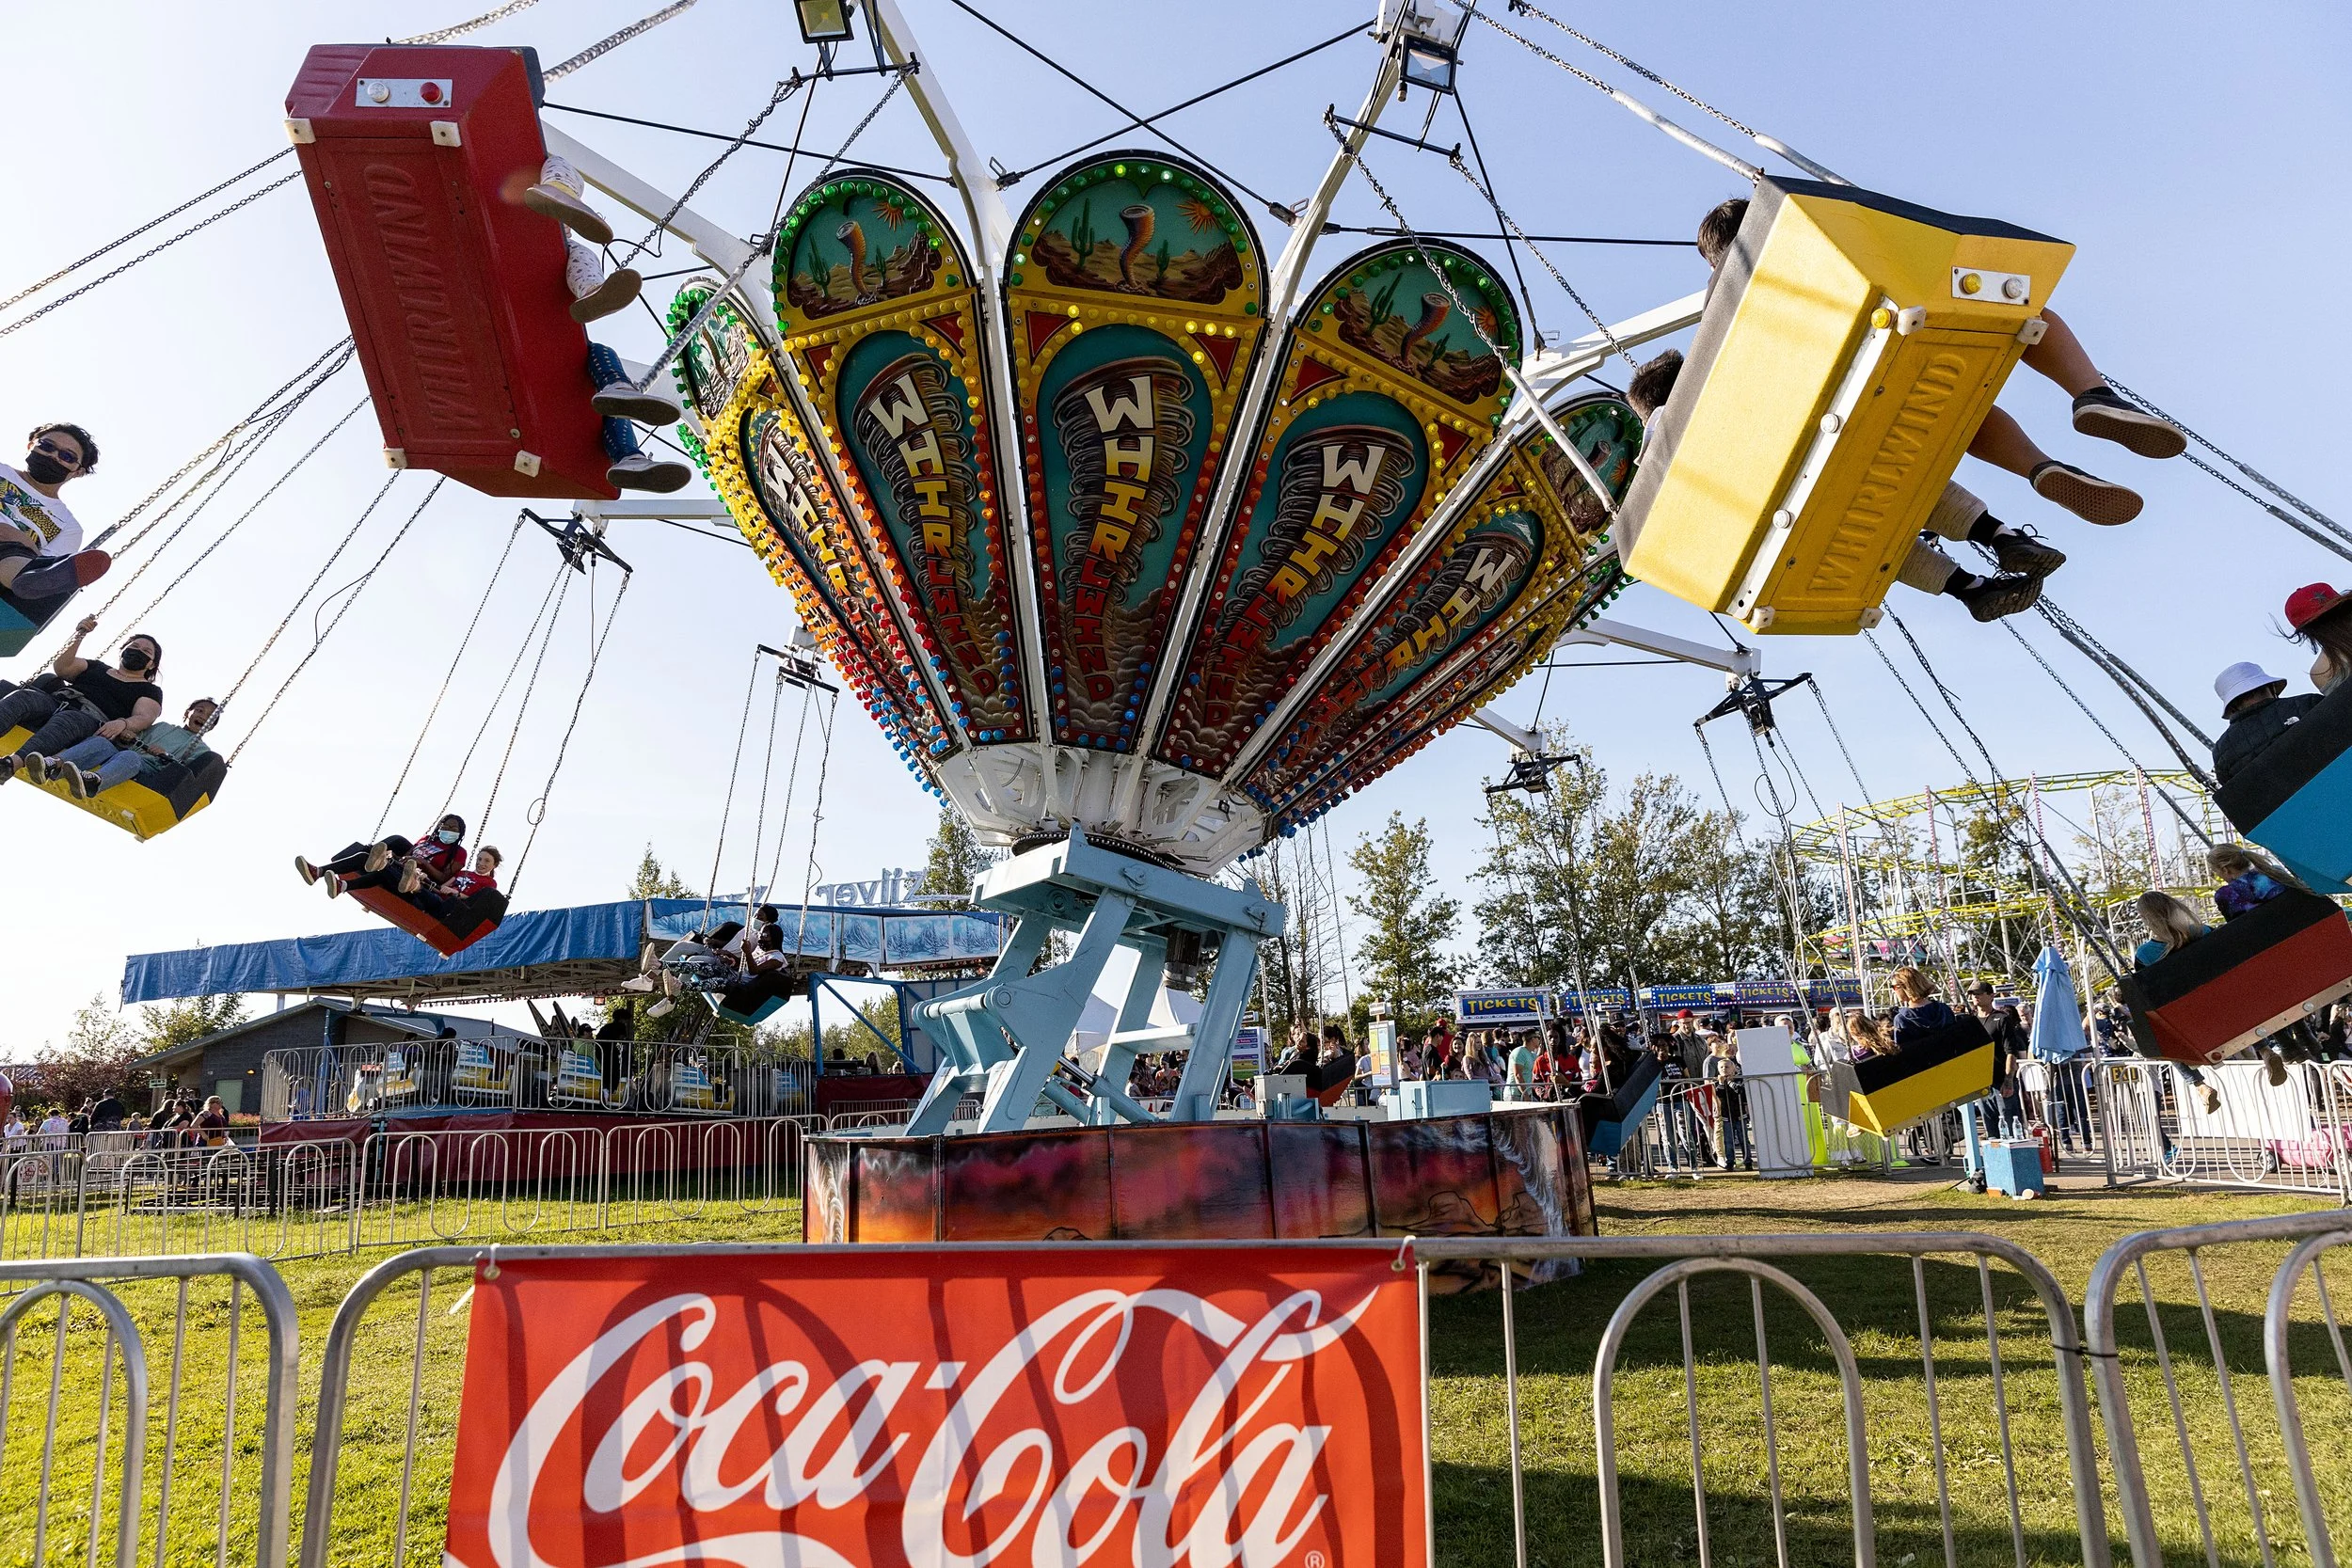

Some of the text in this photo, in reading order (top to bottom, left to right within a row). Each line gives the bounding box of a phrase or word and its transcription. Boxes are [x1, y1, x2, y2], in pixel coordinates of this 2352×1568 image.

[363, 163, 481, 433] WHIRLWIND
[869, 374, 995, 698] WHIRLWIND
[1074, 375, 1154, 702] WHIRLWIND
[1205, 444, 1386, 728] WHIRLWIND
[1807, 353, 1966, 592] WHIRLWIND
[1468, 997, 1538, 1014] TICKETS
[1571, 994, 1626, 1006] TCKETS
[1659, 991, 1711, 1004] TICKETS
[1741, 987, 1789, 999] TICKETS
[1816, 984, 1863, 996] TICKETS
[488, 1285, 1380, 1568] Coca-Cola
